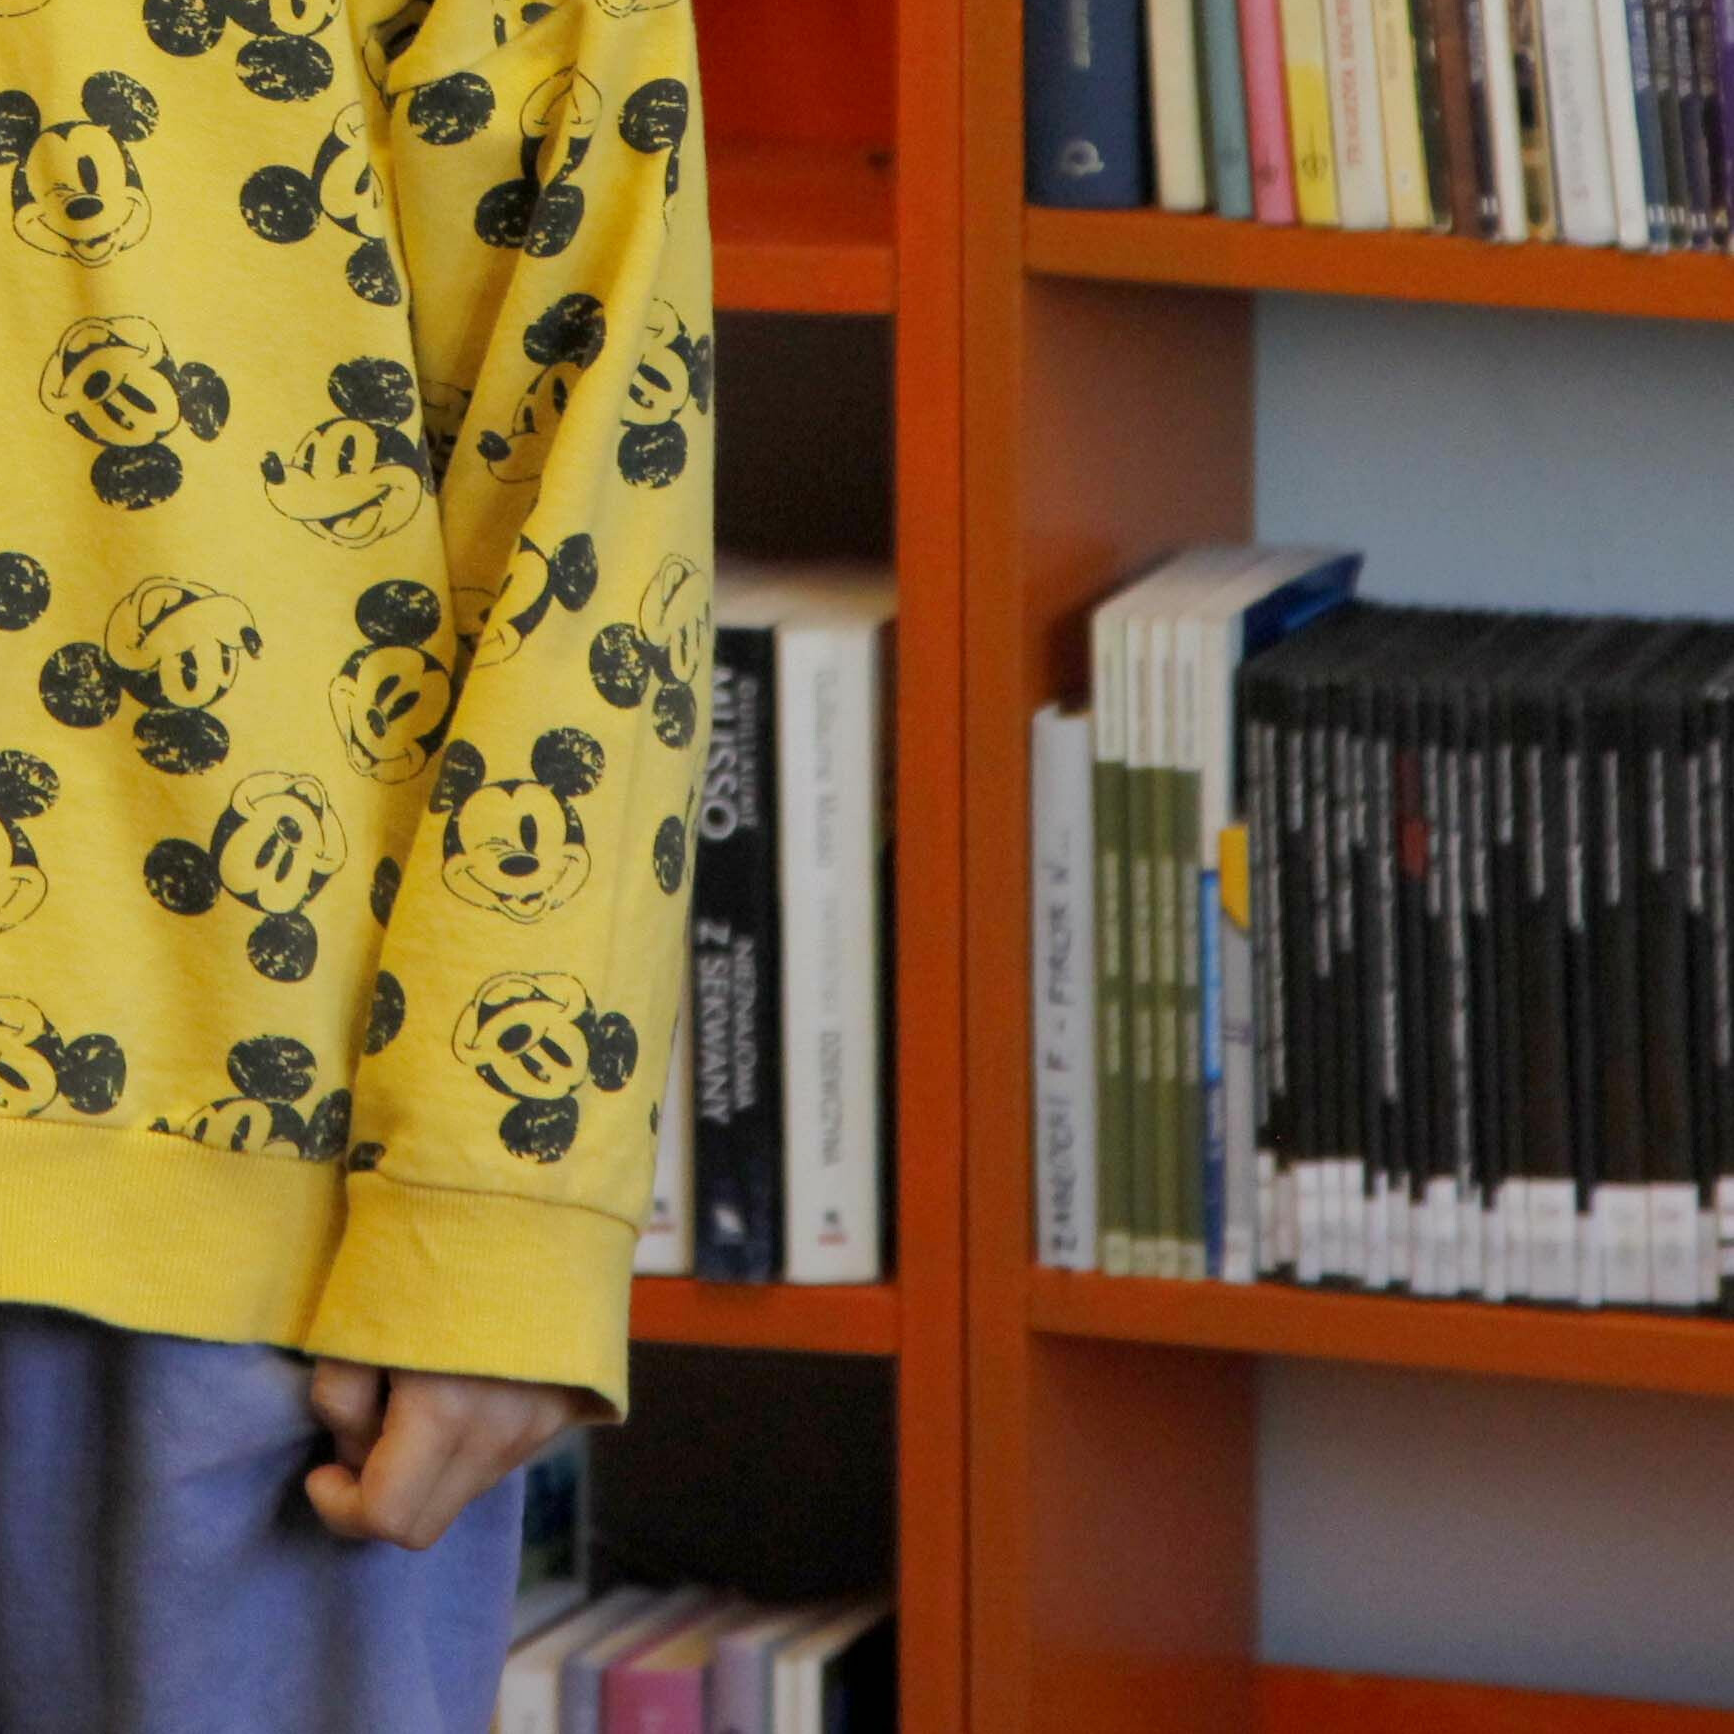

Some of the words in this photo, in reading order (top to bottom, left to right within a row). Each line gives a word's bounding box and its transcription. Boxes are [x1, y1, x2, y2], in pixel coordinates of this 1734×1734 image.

[700, 667, 739, 843] MUSSO
[697, 920, 731, 947] Z
[697, 956, 731, 1127] SEKWANY
